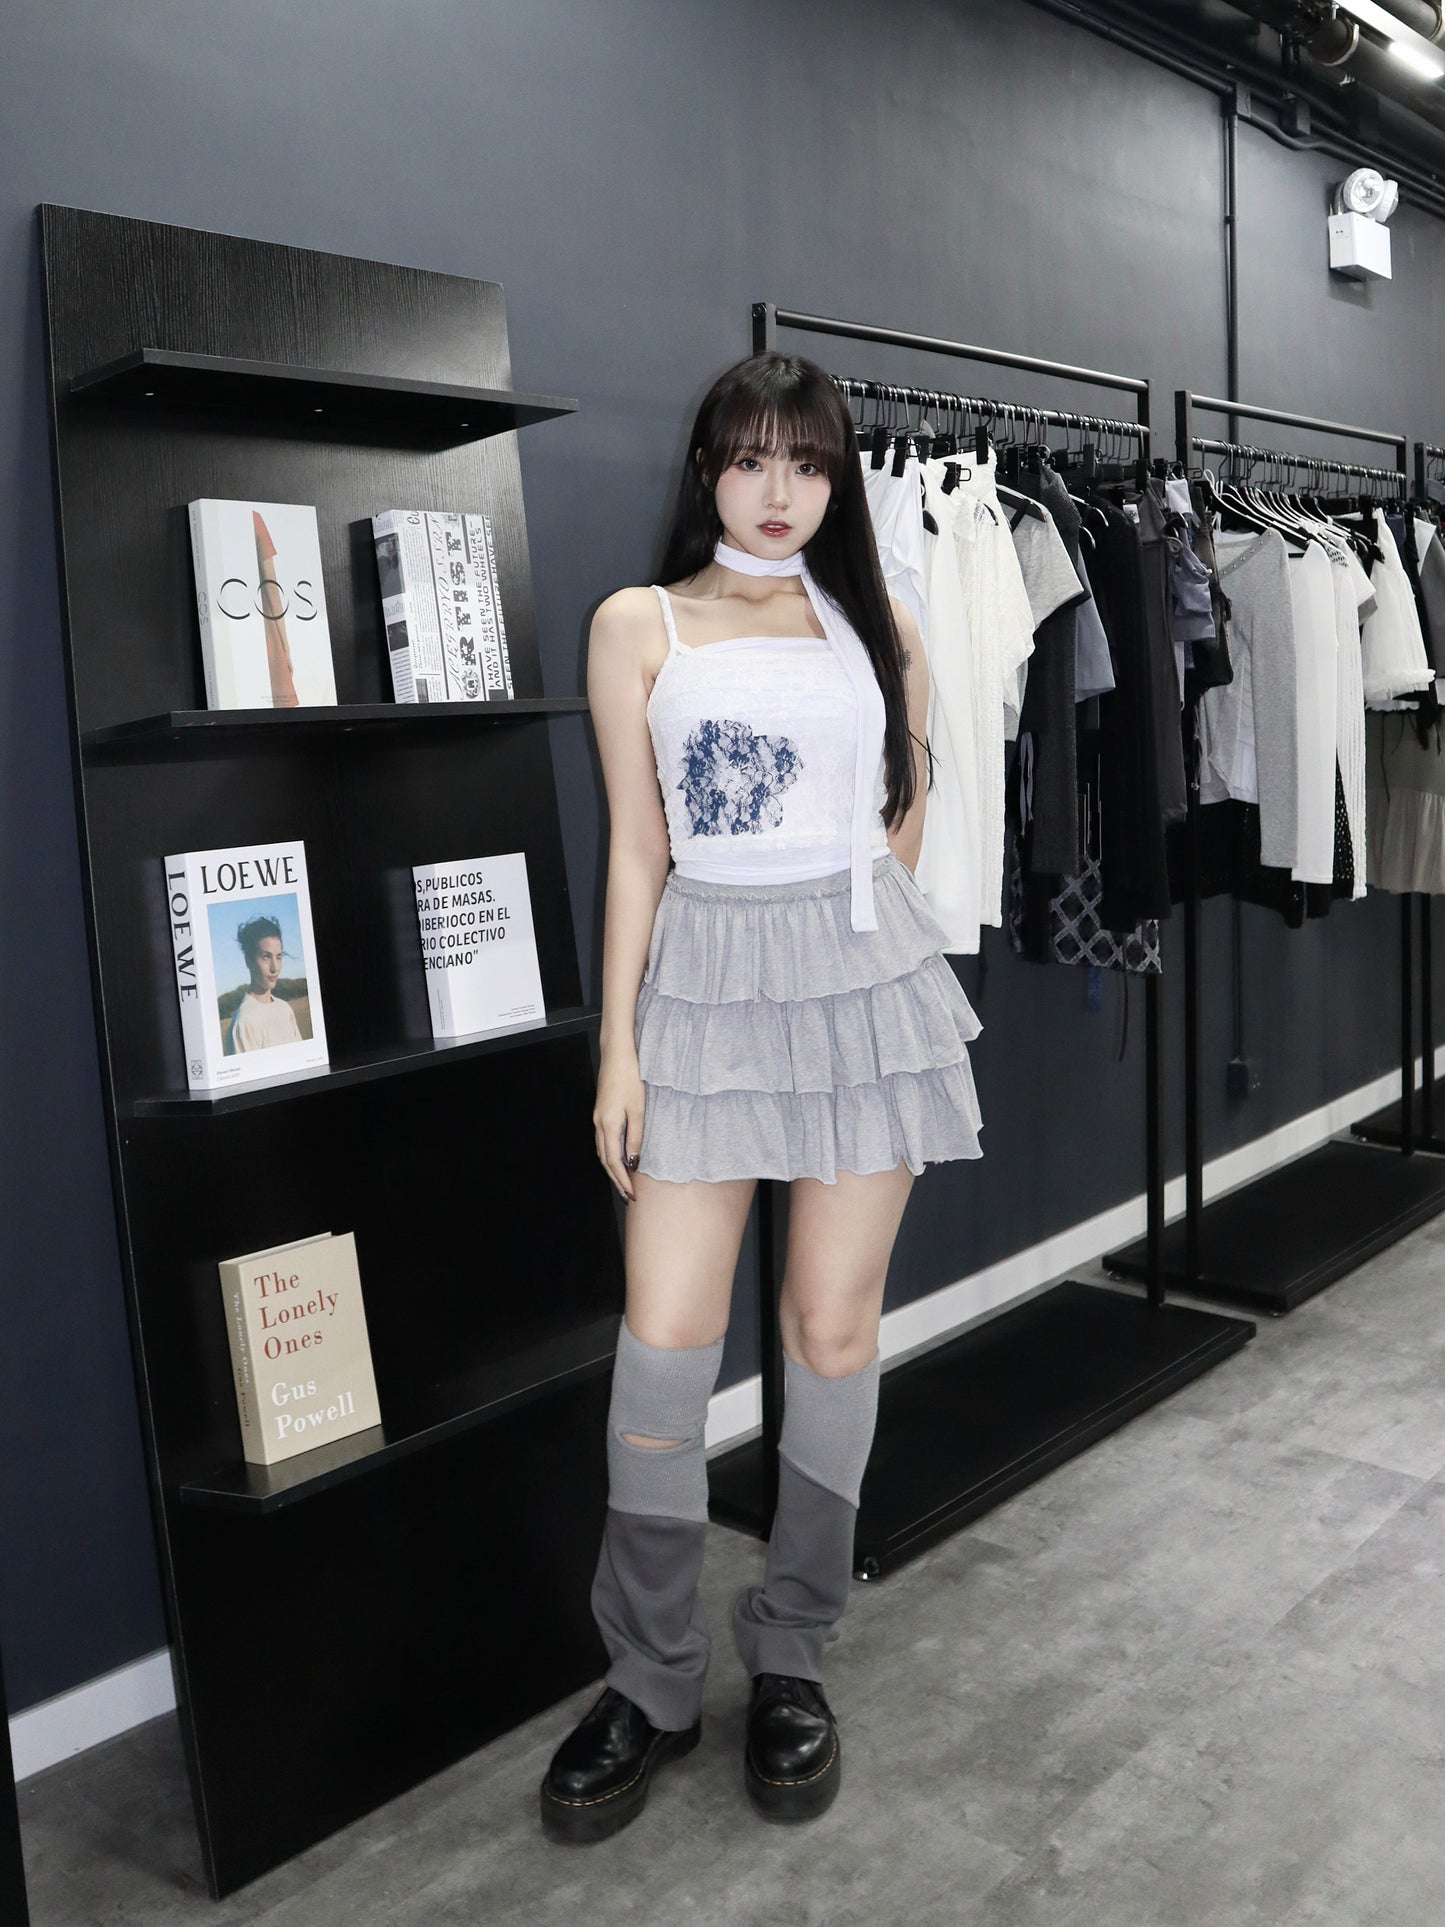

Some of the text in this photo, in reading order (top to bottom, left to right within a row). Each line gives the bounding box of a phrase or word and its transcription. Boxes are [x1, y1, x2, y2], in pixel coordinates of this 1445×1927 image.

[216, 578, 318, 621] COS
[475, 581, 484, 604] THE
[475, 527, 502, 688] AND IT HAS TWO WHEELS
[480, 607, 489, 642] SEEN
[484, 647, 494, 681] HAVE
[200, 856, 299, 894] LOEWE
[433, 896, 449, 910] DE
[452, 889, 496, 908] MASAS.
[479, 908, 494, 924] EN
[497, 907, 511, 921] EL
[167, 870, 199, 1003] LOEWE
[440, 926, 506, 950] COLECTIVO
[253, 1271, 301, 1299] The
[258, 1289, 339, 1330] Lonely
[263, 1329, 323, 1360] Ones
[271, 1377, 317, 1407] Gus
[274, 1391, 357, 1441] Powell
